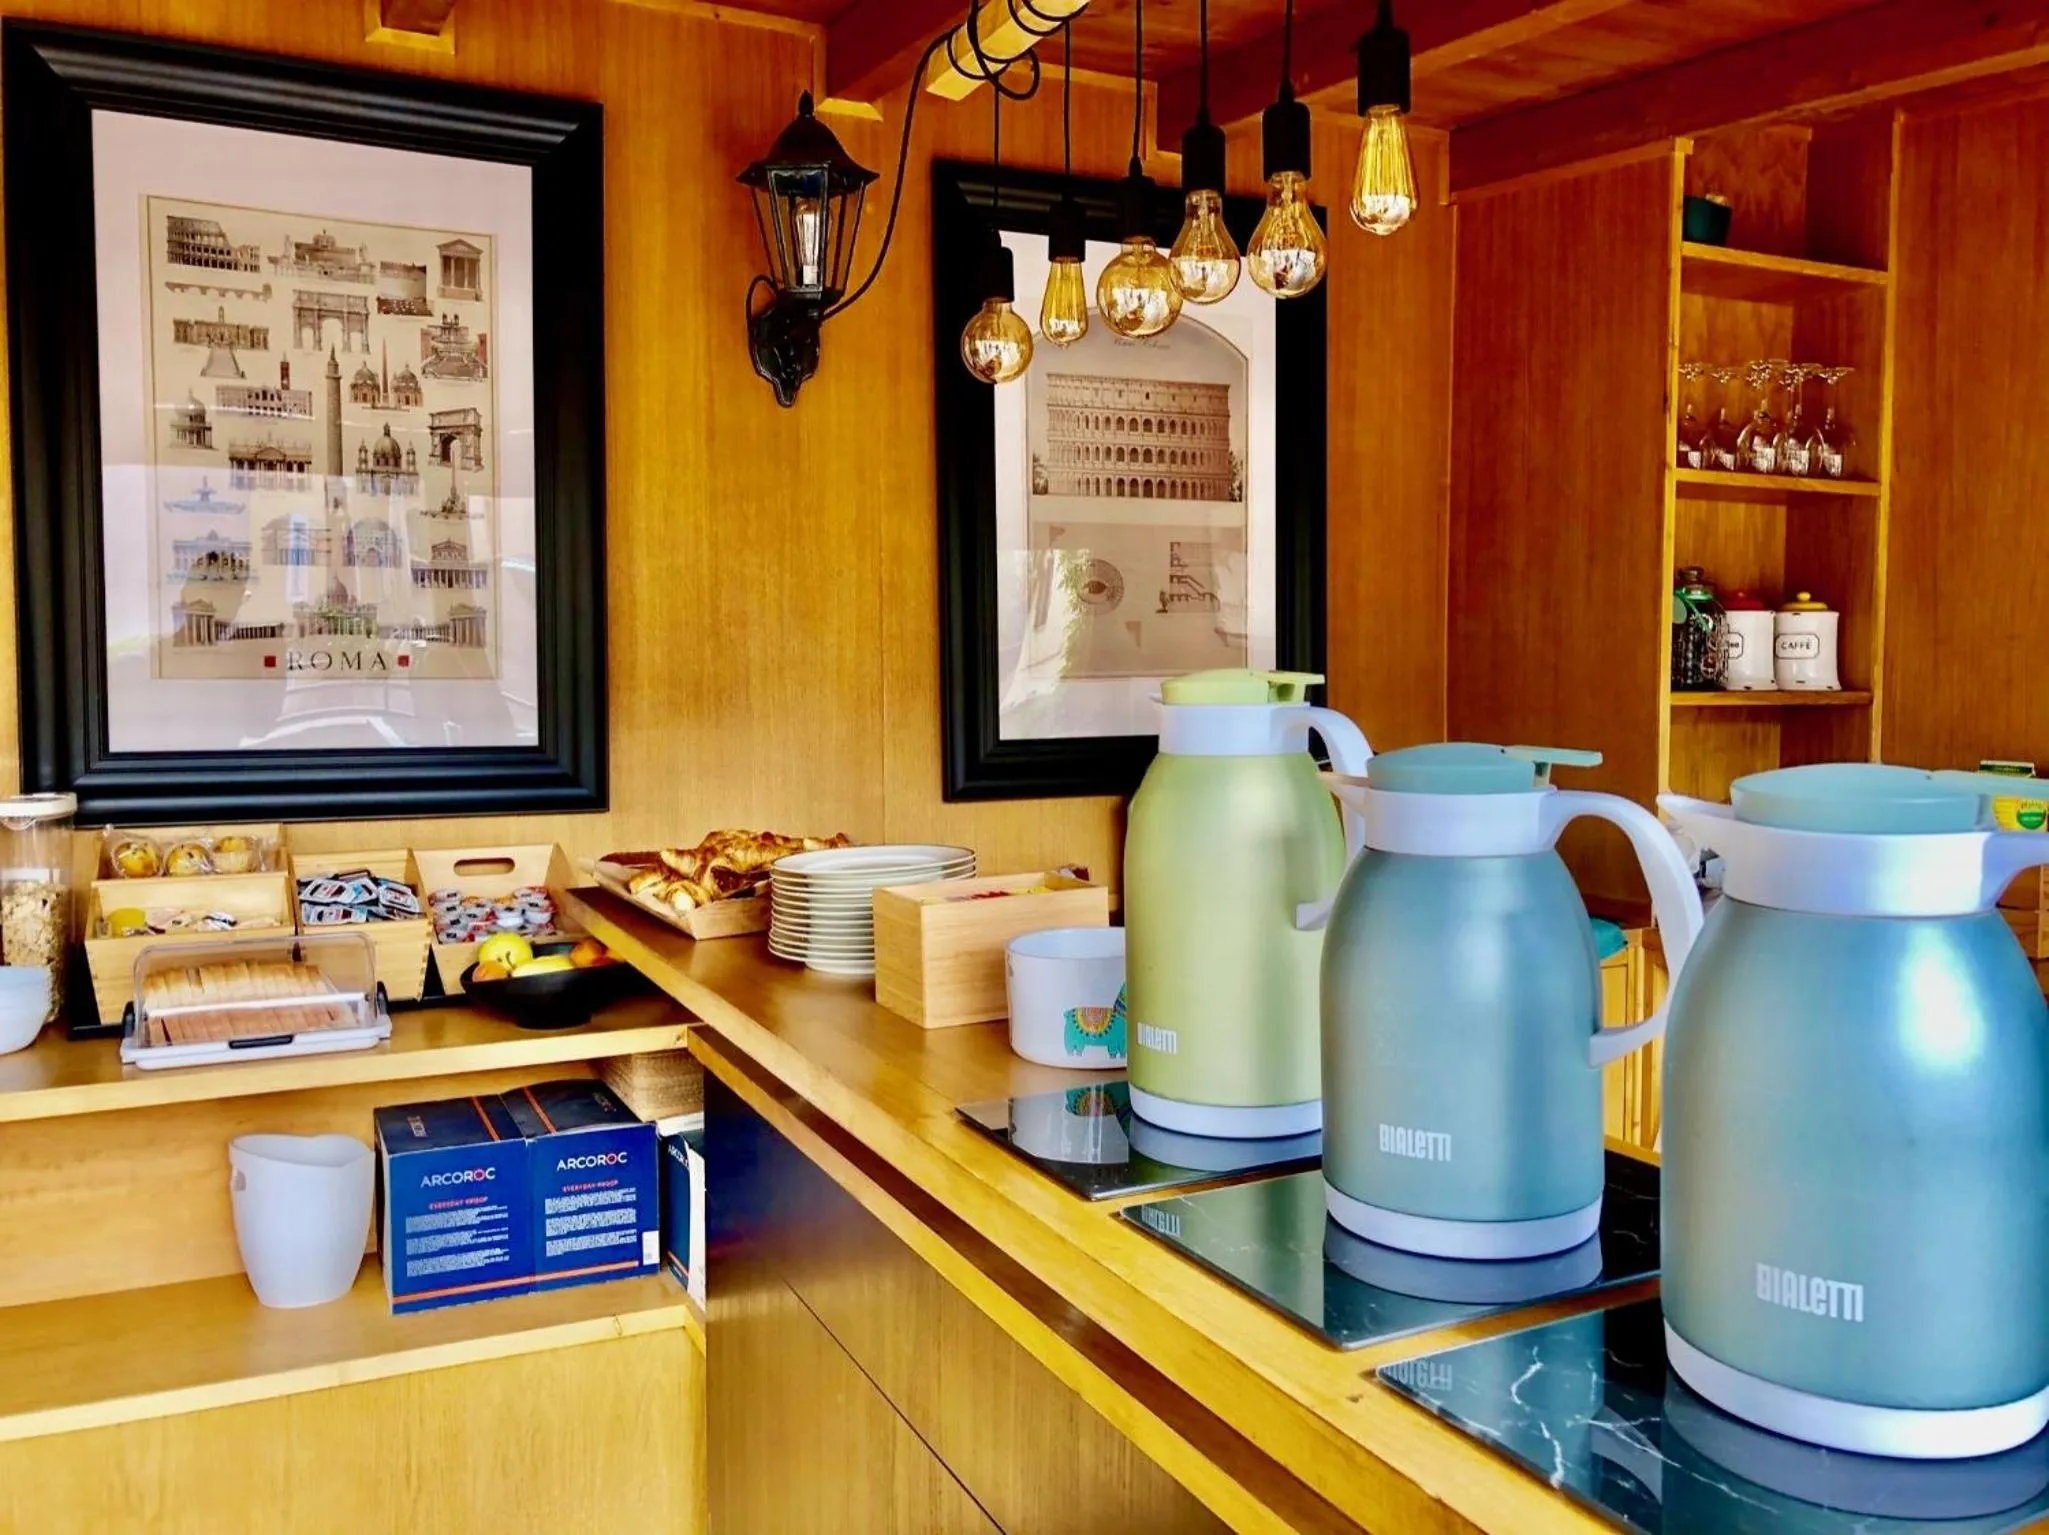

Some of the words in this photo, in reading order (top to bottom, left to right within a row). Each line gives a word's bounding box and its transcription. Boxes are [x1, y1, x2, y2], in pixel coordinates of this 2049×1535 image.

[287, 651, 388, 671] ROMA
[556, 1151, 628, 1171] ARCOROC
[420, 1167, 496, 1188] ARCOROC
